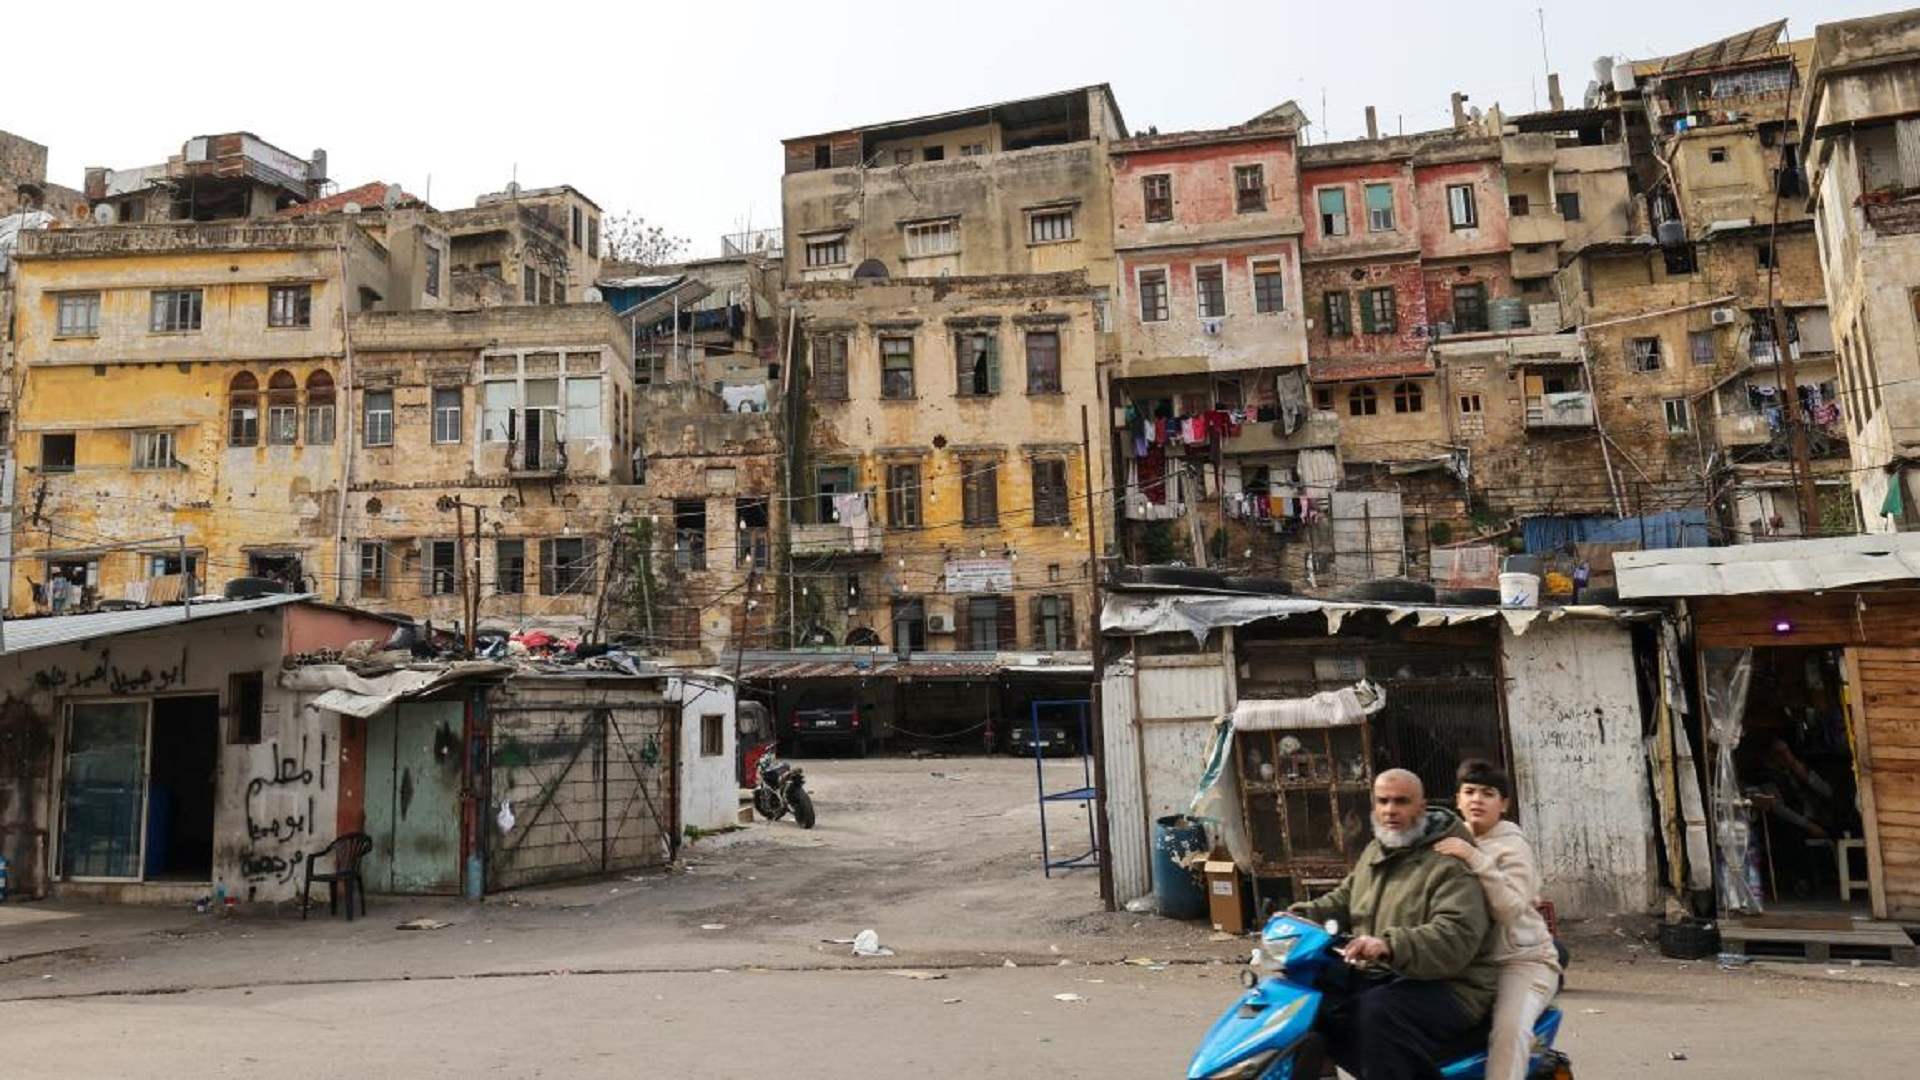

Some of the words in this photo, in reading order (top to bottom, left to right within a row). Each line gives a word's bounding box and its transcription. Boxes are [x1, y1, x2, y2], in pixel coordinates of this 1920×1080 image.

[156, 646, 187, 690] ابو
[247, 733, 327, 812] المعلم
[278, 797, 314, 842] ابو
